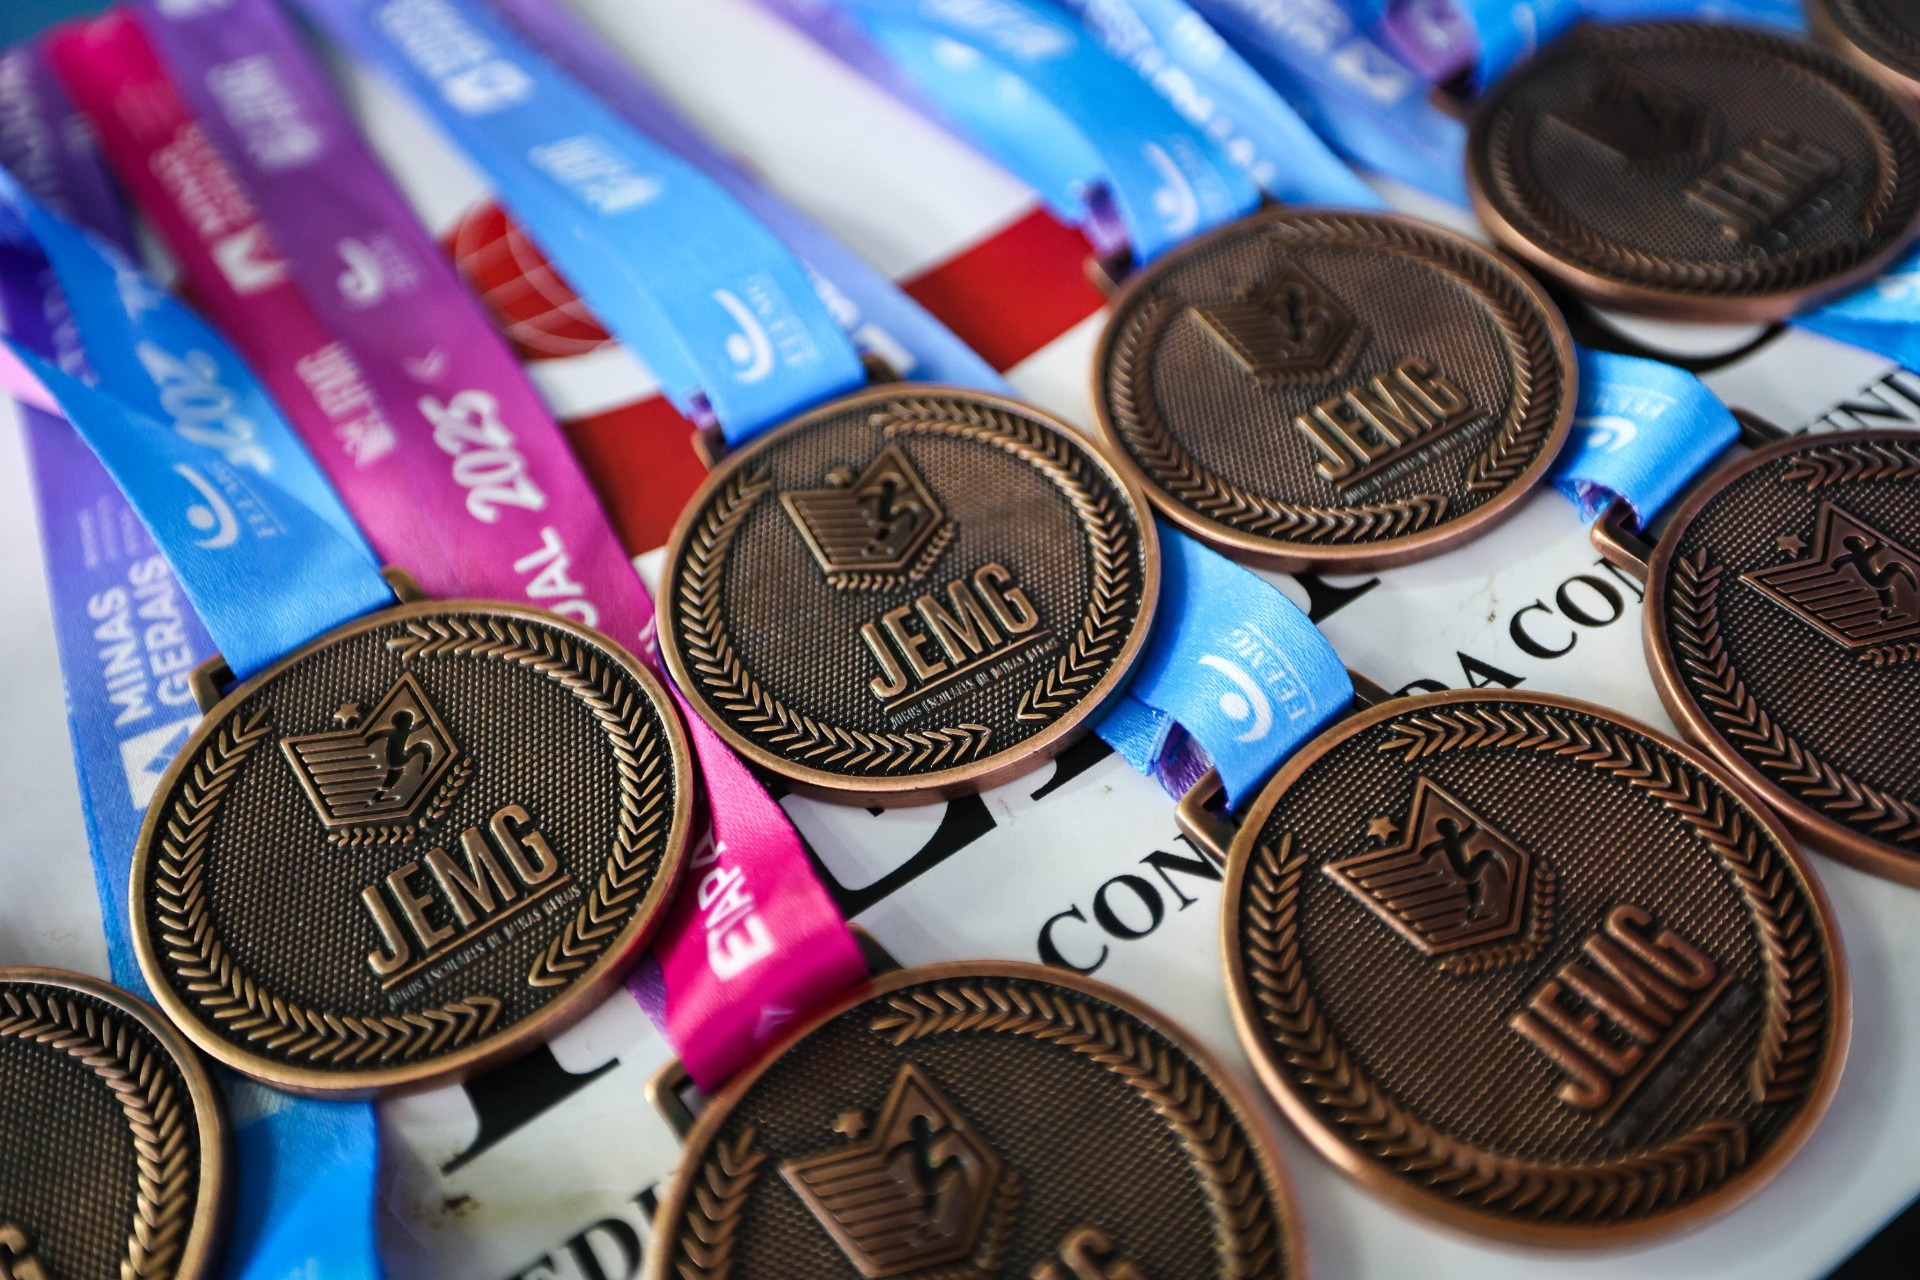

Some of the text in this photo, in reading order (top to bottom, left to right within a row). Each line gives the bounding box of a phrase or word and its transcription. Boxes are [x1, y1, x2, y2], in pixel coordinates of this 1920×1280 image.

[1294, 356, 1470, 482] JEMG
[87, 584, 155, 728] MINAS
[128, 553, 197, 707] GERAIS
[860, 562, 1039, 699] JEMG
[361, 804, 558, 976] JEMG
[1508, 904, 1717, 1111] JEMG
